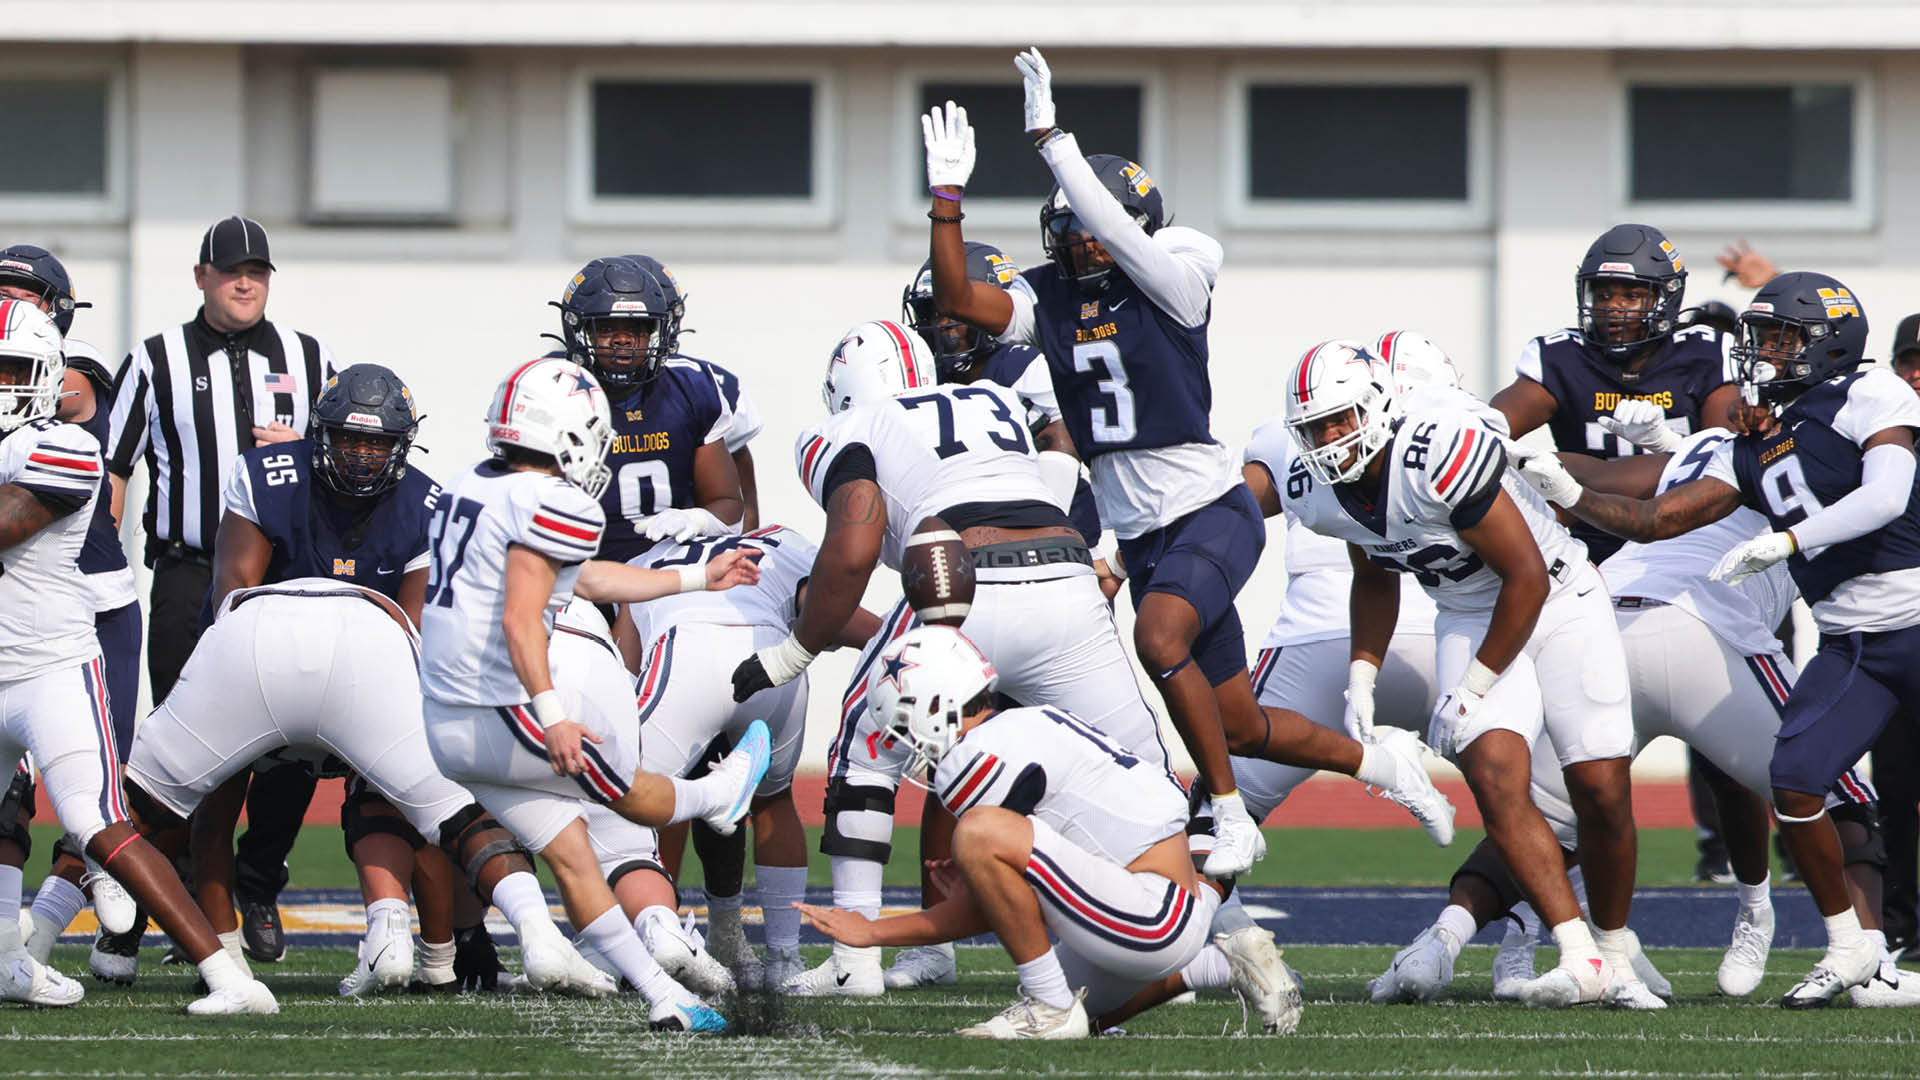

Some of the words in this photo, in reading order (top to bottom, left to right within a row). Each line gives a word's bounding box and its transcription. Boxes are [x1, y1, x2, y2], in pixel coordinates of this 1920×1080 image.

[196, 376, 208, 391] S
[1073, 339, 1137, 442] 3
[1595, 391, 1673, 411] BUGS
[896, 388, 1030, 460] 73
[612, 431, 670, 454] BULLDOGS
[1759, 437, 1795, 465] ULLDOGS
[262, 454, 299, 486] 95
[1761, 453, 1831, 562] 9
[424, 492, 485, 608] 37
